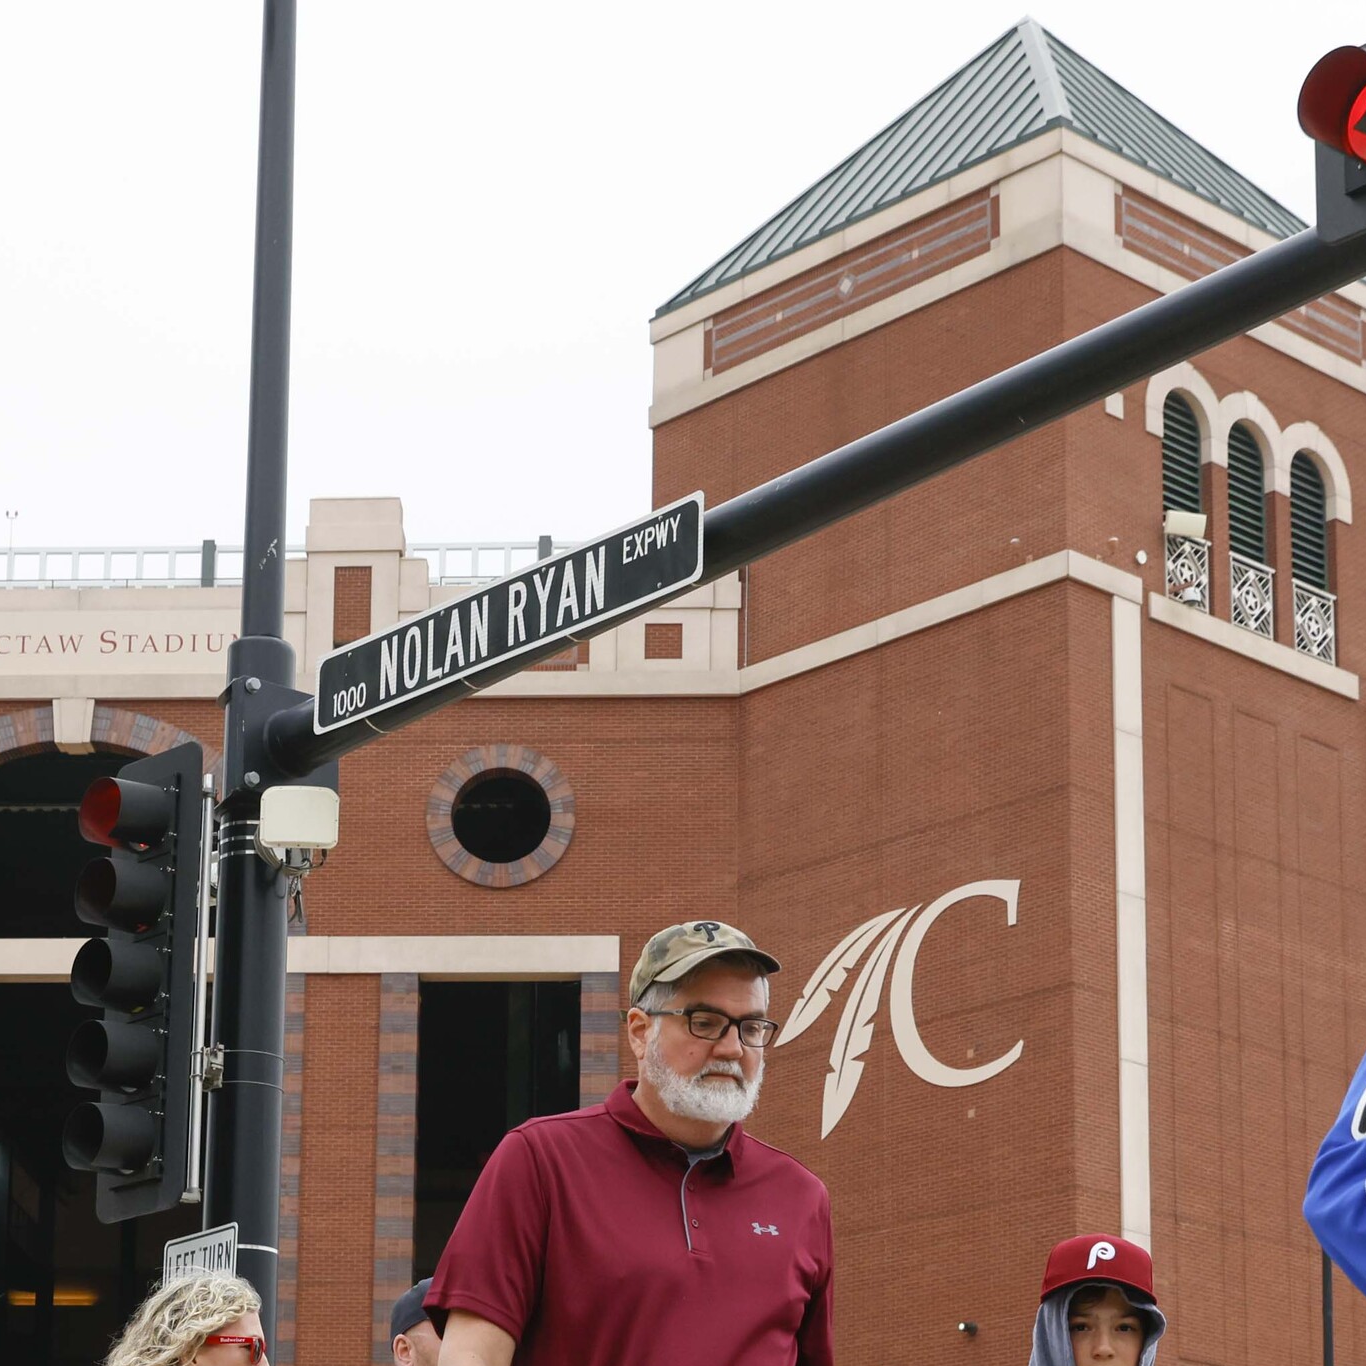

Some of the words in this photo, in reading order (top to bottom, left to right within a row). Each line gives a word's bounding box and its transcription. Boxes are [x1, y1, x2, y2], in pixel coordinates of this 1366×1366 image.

[332, 682, 367, 718] 1000
[378, 595, 489, 701] NOLAN
[506, 546, 606, 648] RYAN
[622, 513, 682, 565] EXPWY
[693, 922, 720, 943] P
[889, 879, 1024, 1088] C
[1087, 1241, 1116, 1270] P
